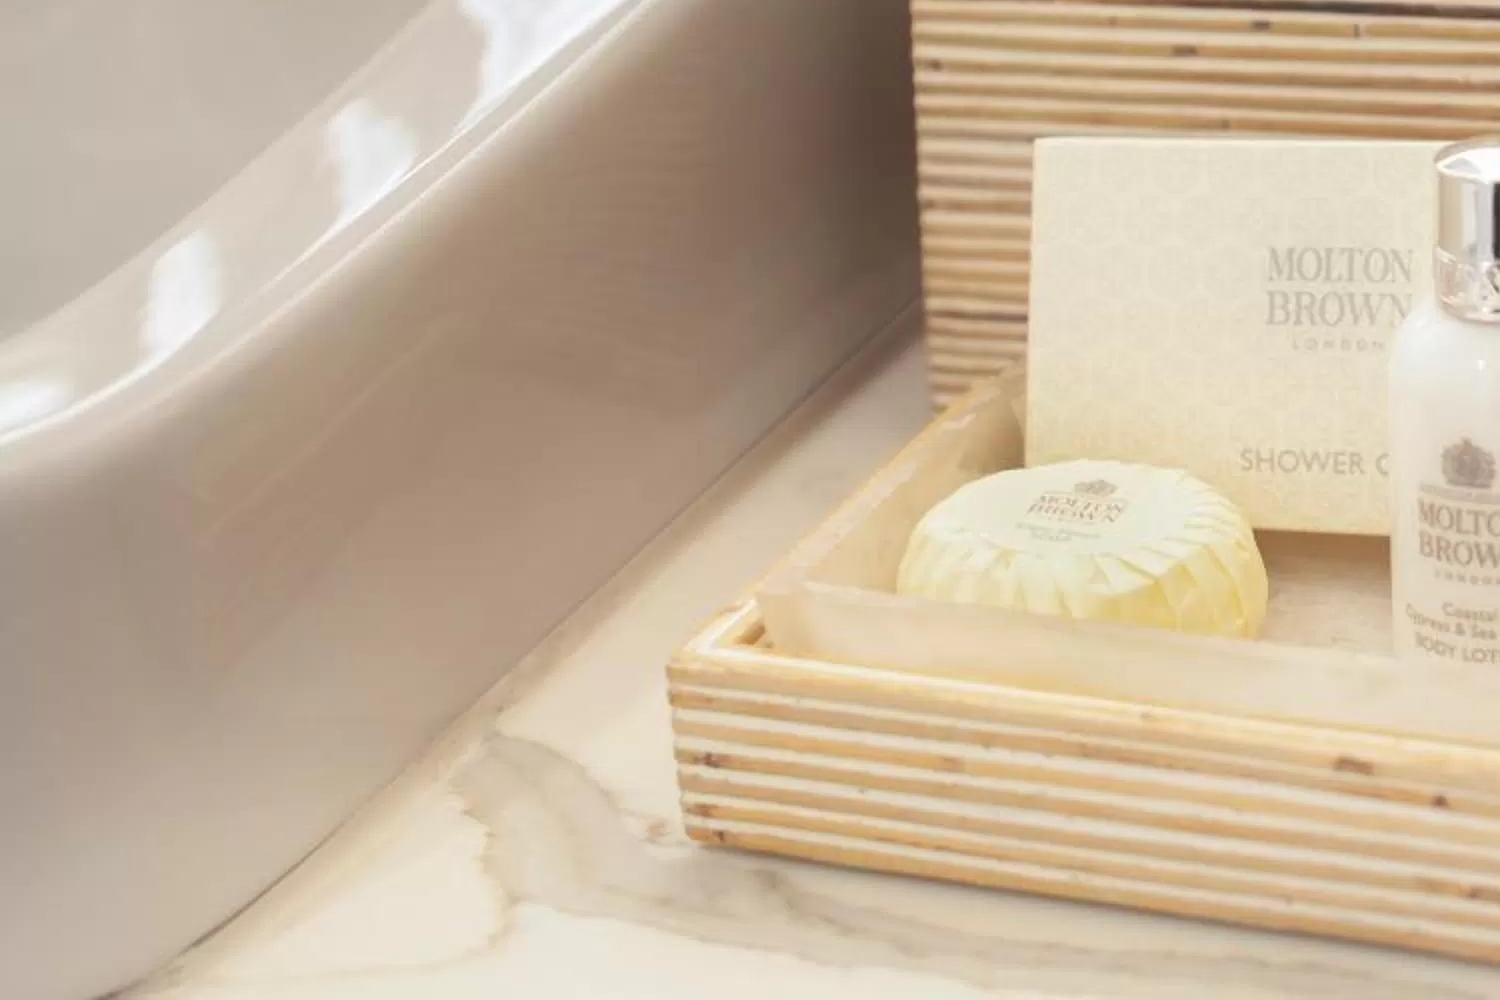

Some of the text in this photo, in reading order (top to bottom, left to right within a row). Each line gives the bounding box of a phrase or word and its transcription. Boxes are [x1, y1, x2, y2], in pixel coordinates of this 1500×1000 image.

[1267, 246, 1412, 284] MOLTON
[1265, 290, 1412, 327] BROWN
[1239, 447, 1367, 476] SHOWER
